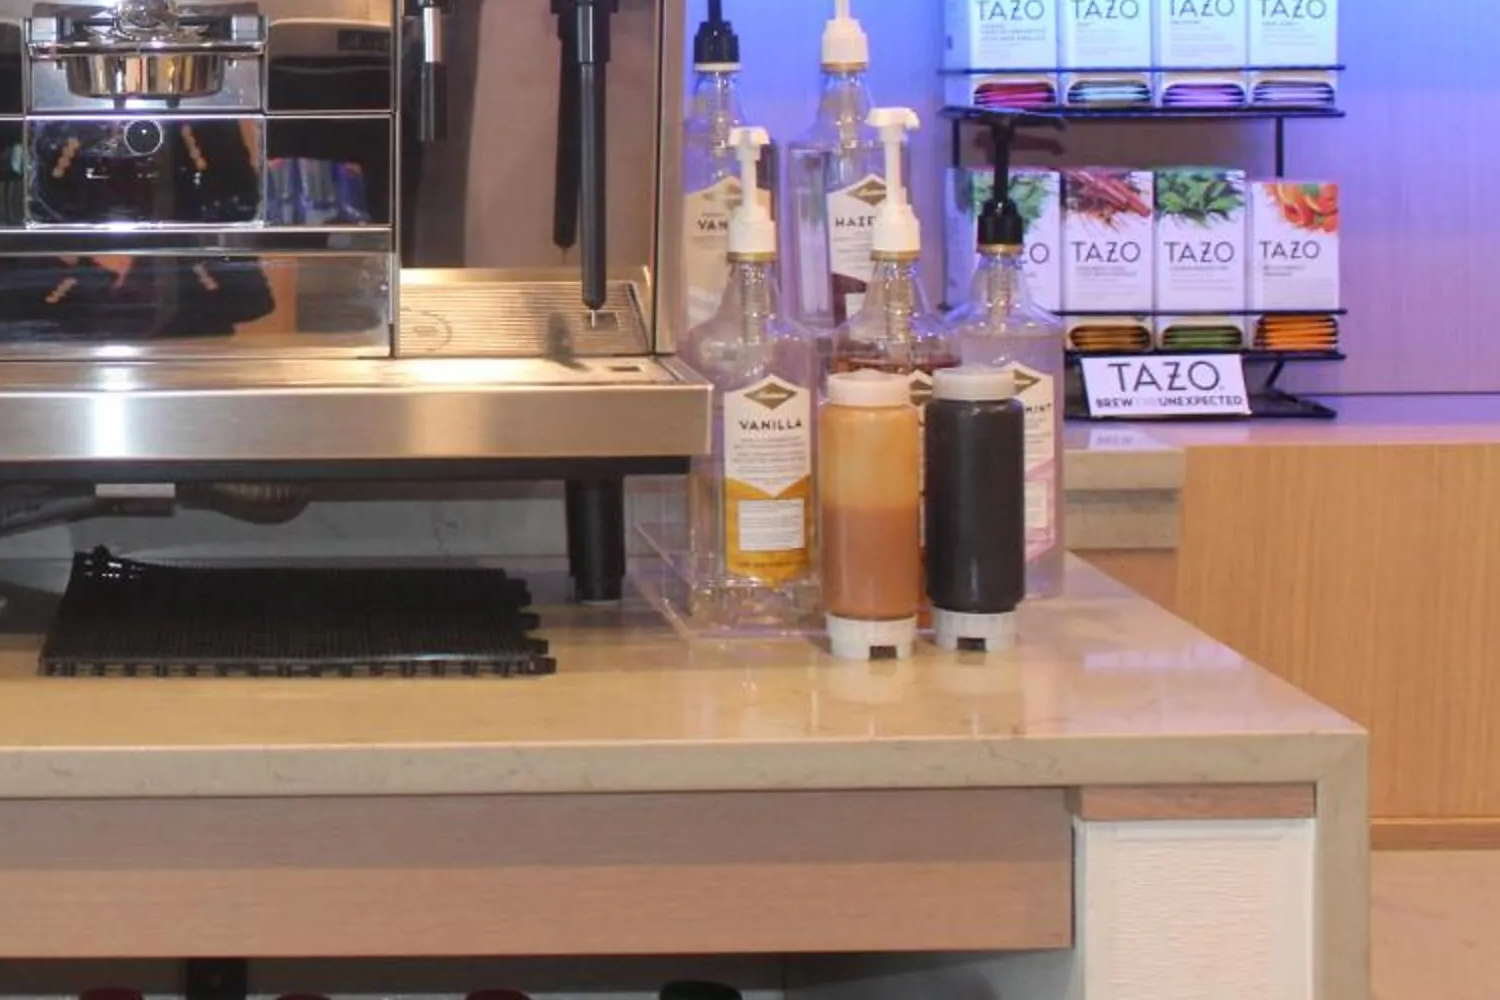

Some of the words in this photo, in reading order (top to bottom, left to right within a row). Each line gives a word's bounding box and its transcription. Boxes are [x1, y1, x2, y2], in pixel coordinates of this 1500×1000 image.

[697, 219, 729, 230] VAN
[835, 215, 877, 228] HAZE
[1070, 241, 1142, 264] TAZO
[1163, 241, 1235, 263] TAZO
[1258, 239, 1322, 260] TAZO
[1107, 360, 1221, 393] TAZO
[1096, 396, 1133, 409] BREW
[1158, 394, 1243, 408] UNEXPECTED
[738, 417, 803, 430] VANILLA
